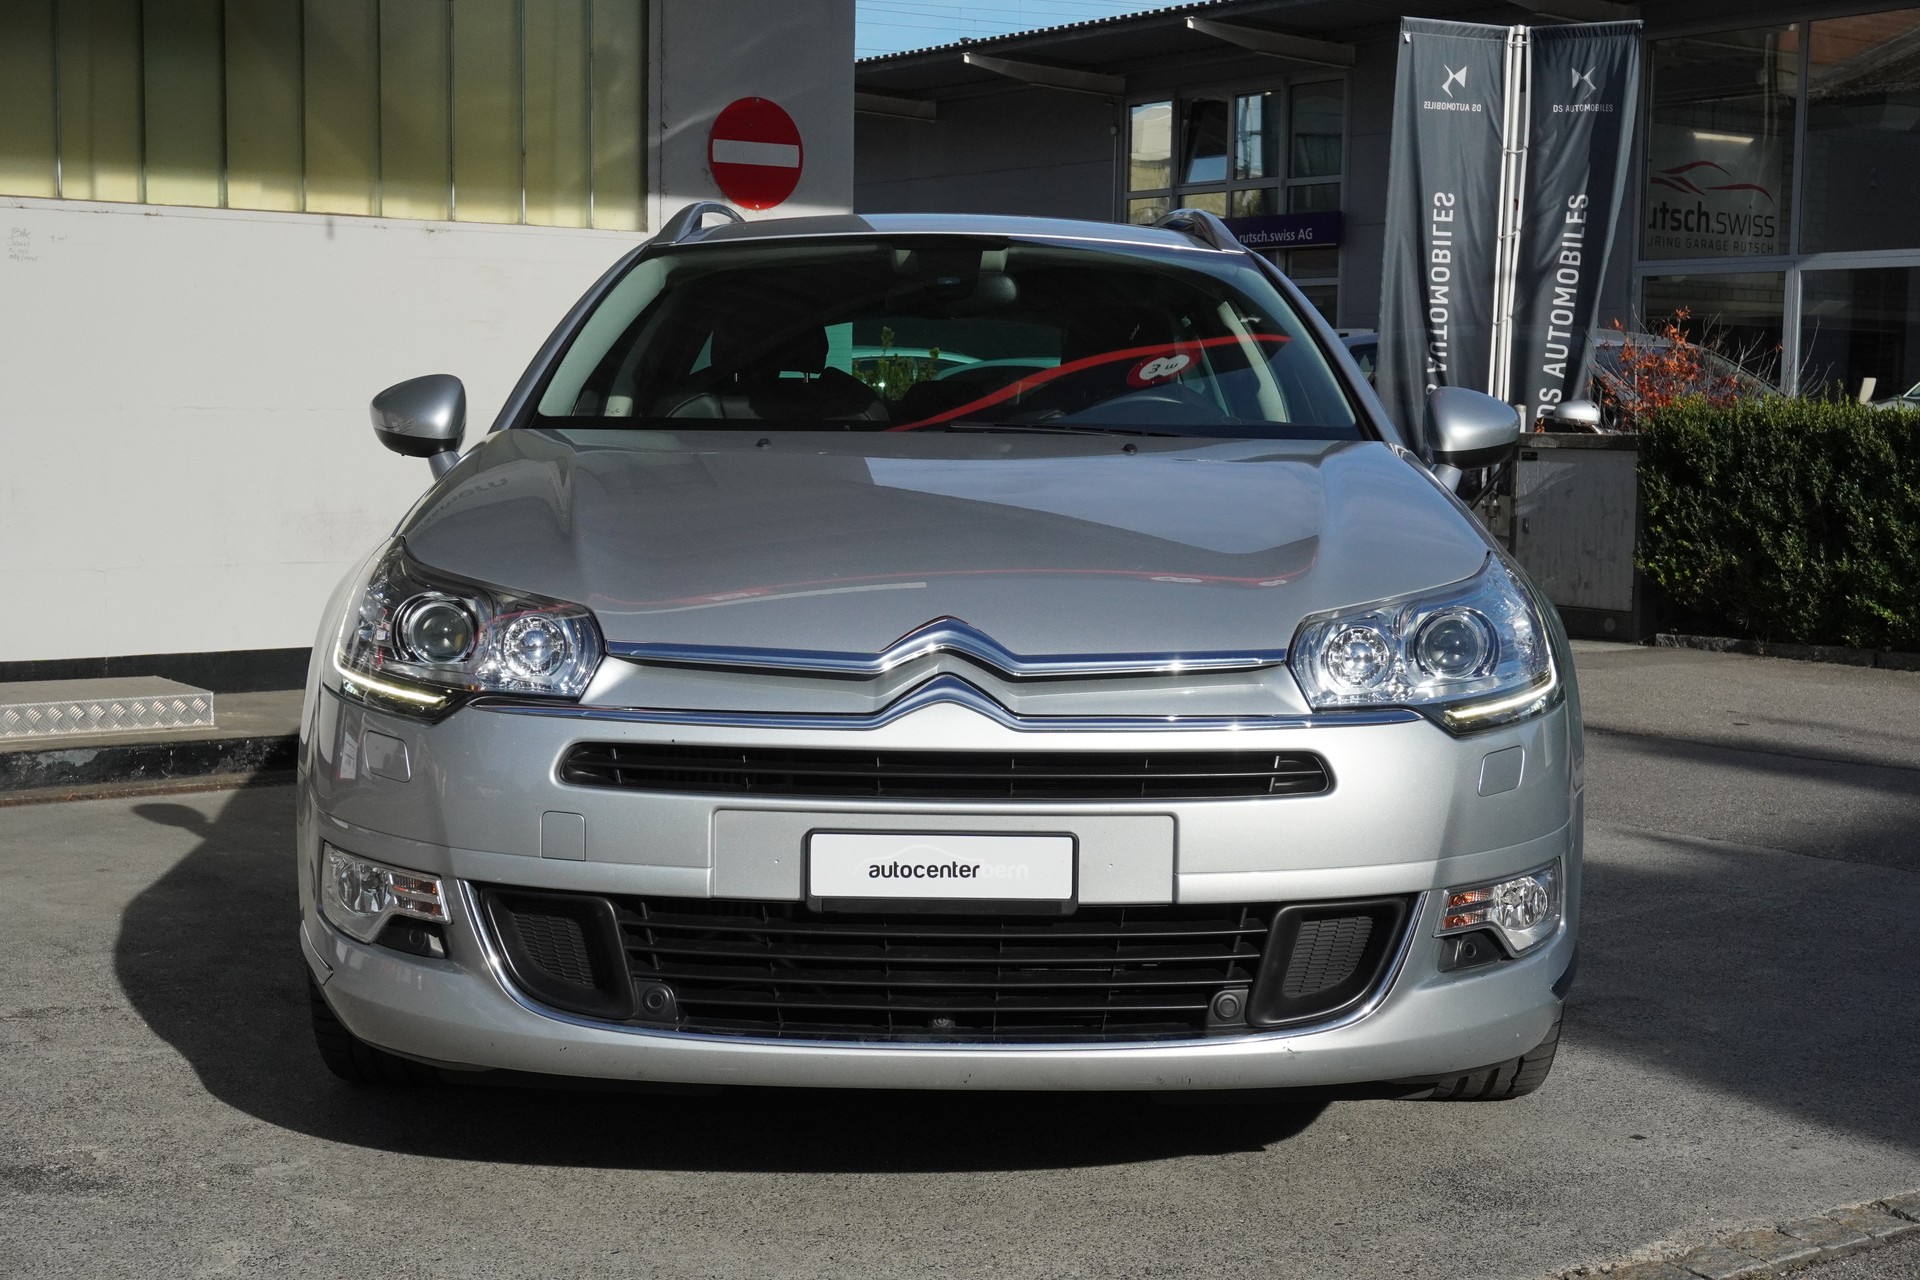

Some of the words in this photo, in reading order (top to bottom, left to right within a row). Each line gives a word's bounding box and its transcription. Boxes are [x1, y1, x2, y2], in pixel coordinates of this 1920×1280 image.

[1553, 104, 1563, 113] DS
[1566, 104, 1614, 113] AUTOMOBILES
[1239, 229, 1295, 243] rutsch.swiss
[1298, 228, 1313, 240] AG
[1685, 238, 1729, 251] GARAGE
[1733, 241, 1774, 254] RUTSCH
[1543, 194, 1589, 379] AUTOMOBILES
